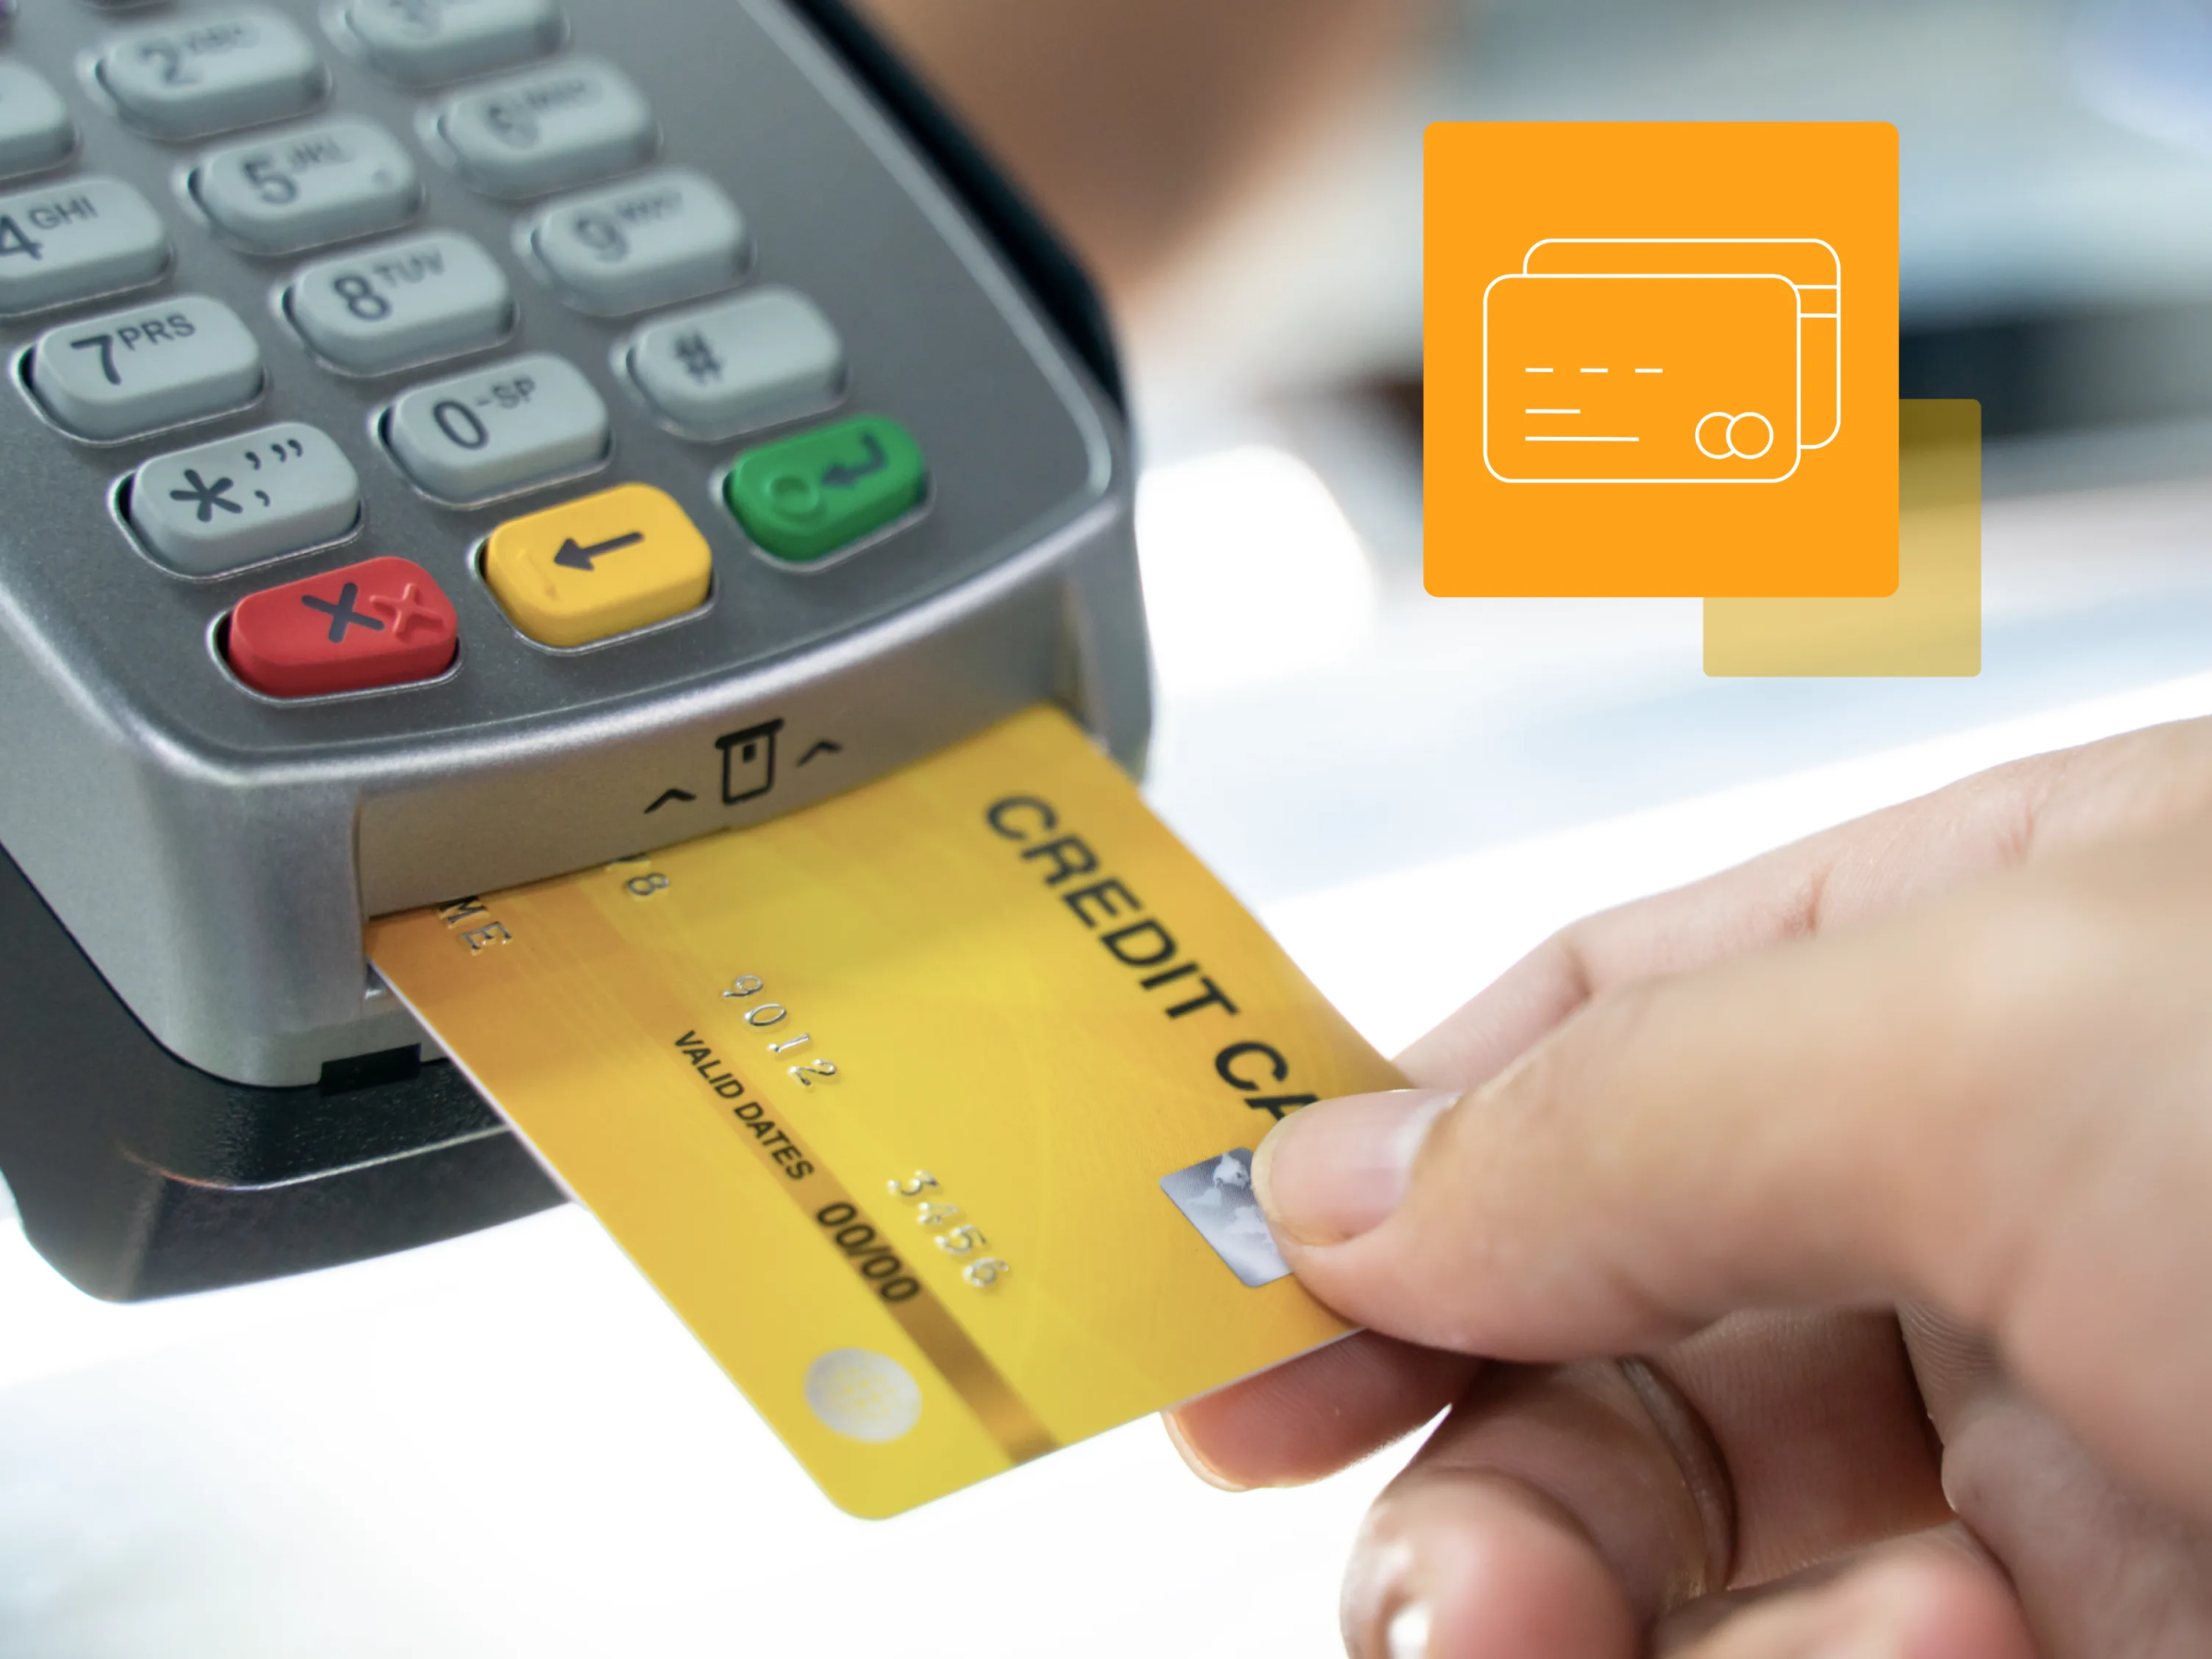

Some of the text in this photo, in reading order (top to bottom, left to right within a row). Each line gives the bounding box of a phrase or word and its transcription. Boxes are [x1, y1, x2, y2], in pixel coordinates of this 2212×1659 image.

[241, 153, 300, 206] 5
[29, 195, 99, 229] GHI
[333, 274, 392, 321] 8
[70, 313, 196, 385] 7 PRS
[433, 400, 489, 450] 0
[983, 793, 1241, 1020] CREDIT
[722, 974, 838, 1088] 9012
[887, 1169, 1010, 1288] 3456
[674, 1030, 921, 1305] VALID DATES 00/00
